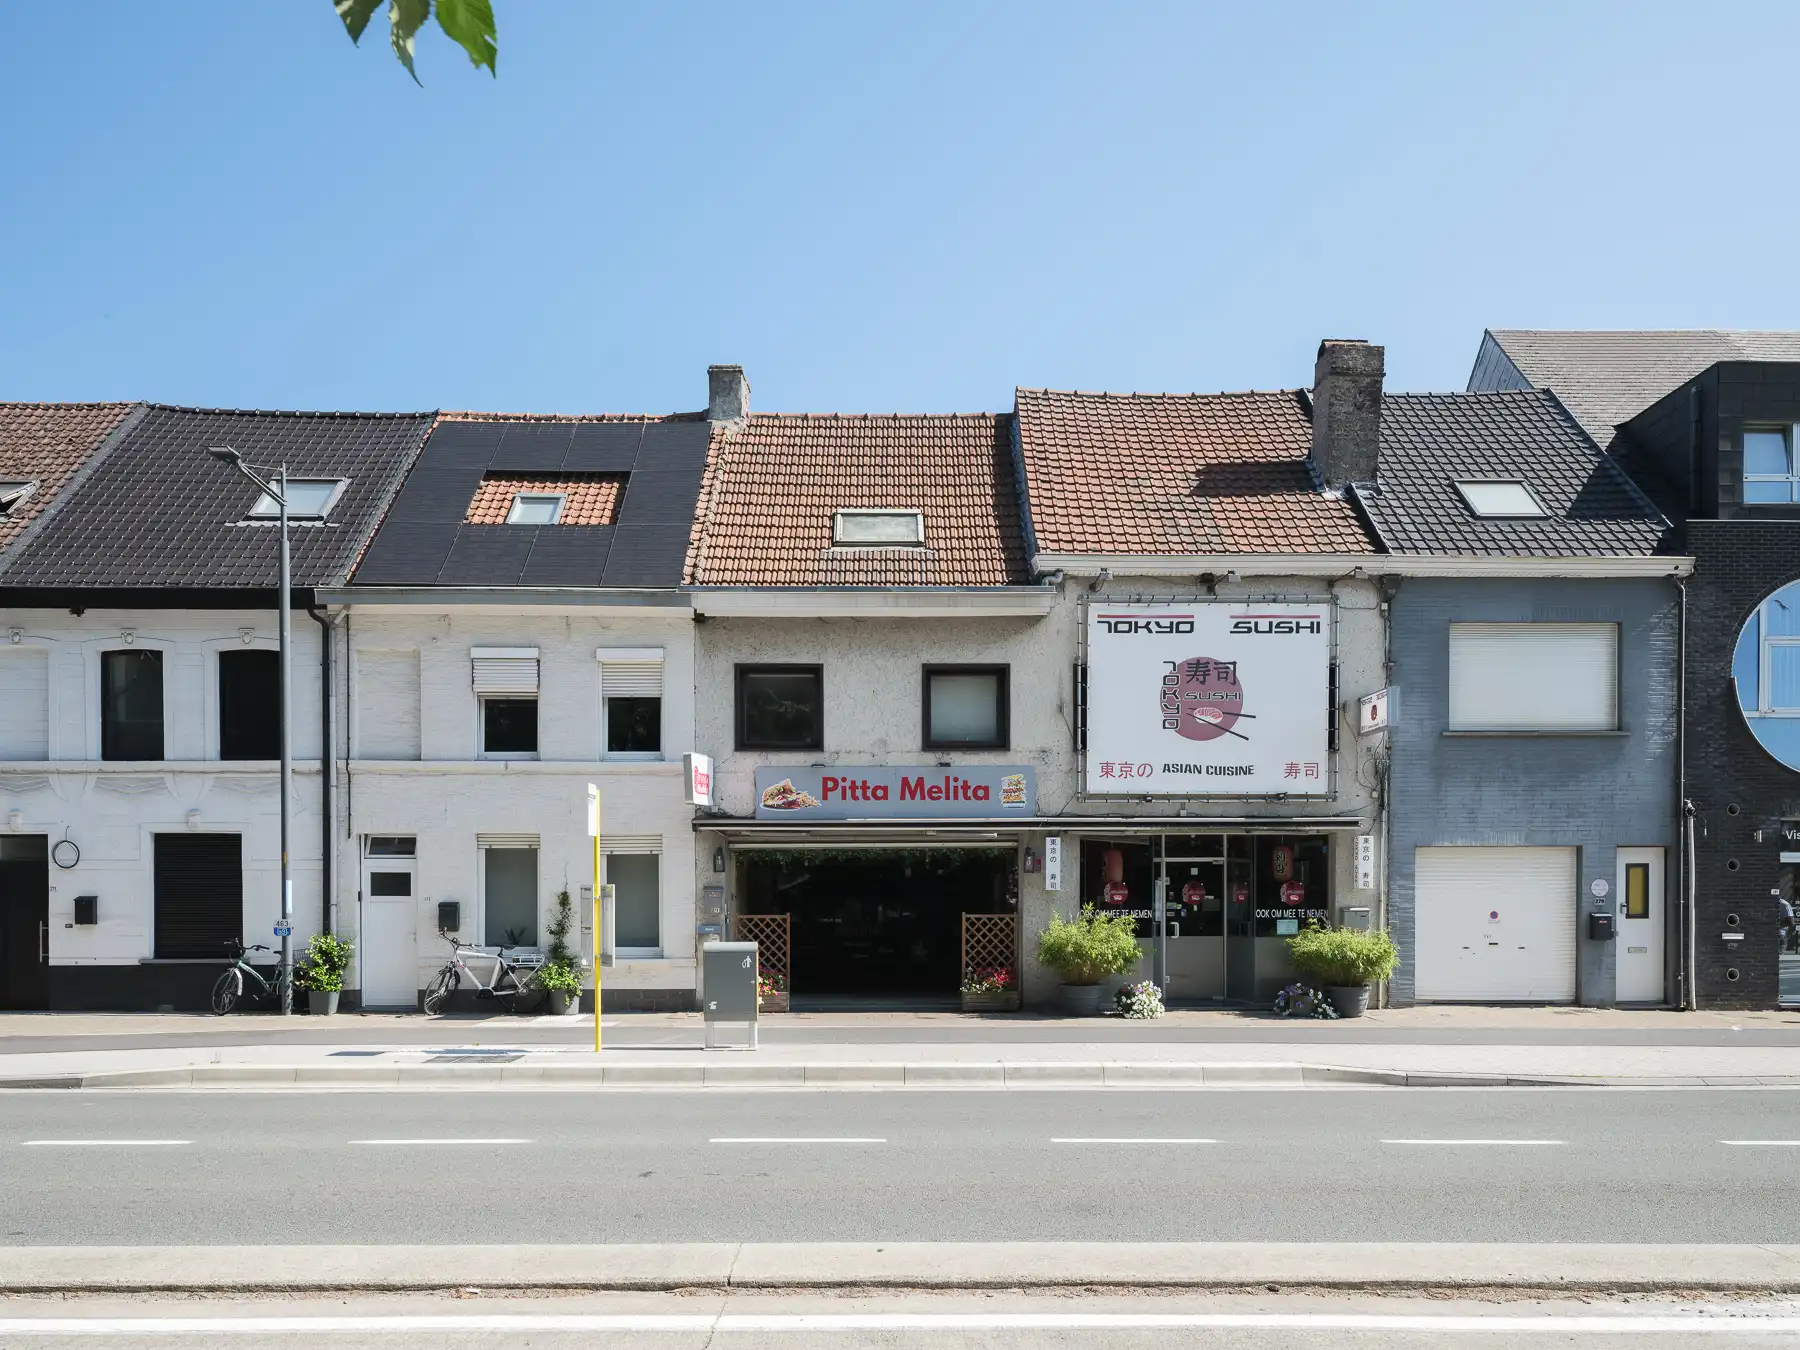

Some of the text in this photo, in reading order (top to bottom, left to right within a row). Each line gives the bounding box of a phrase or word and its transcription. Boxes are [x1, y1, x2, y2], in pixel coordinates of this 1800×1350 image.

[1097, 620, 1321, 634] TOKYO SUSHI
[1185, 658, 1238, 686] 寿司
[1162, 660, 1180, 730] TOKYO
[1183, 691, 1241, 701] SUSHI
[1098, 760, 1154, 780] 東京の
[1162, 763, 1255, 776] ASIAN CUISINE
[1283, 761, 1320, 780] 寿司
[821, 775, 990, 801] Pitta Melita
[1255, 908, 1329, 919] OOK OM MEE TE NEMEN
